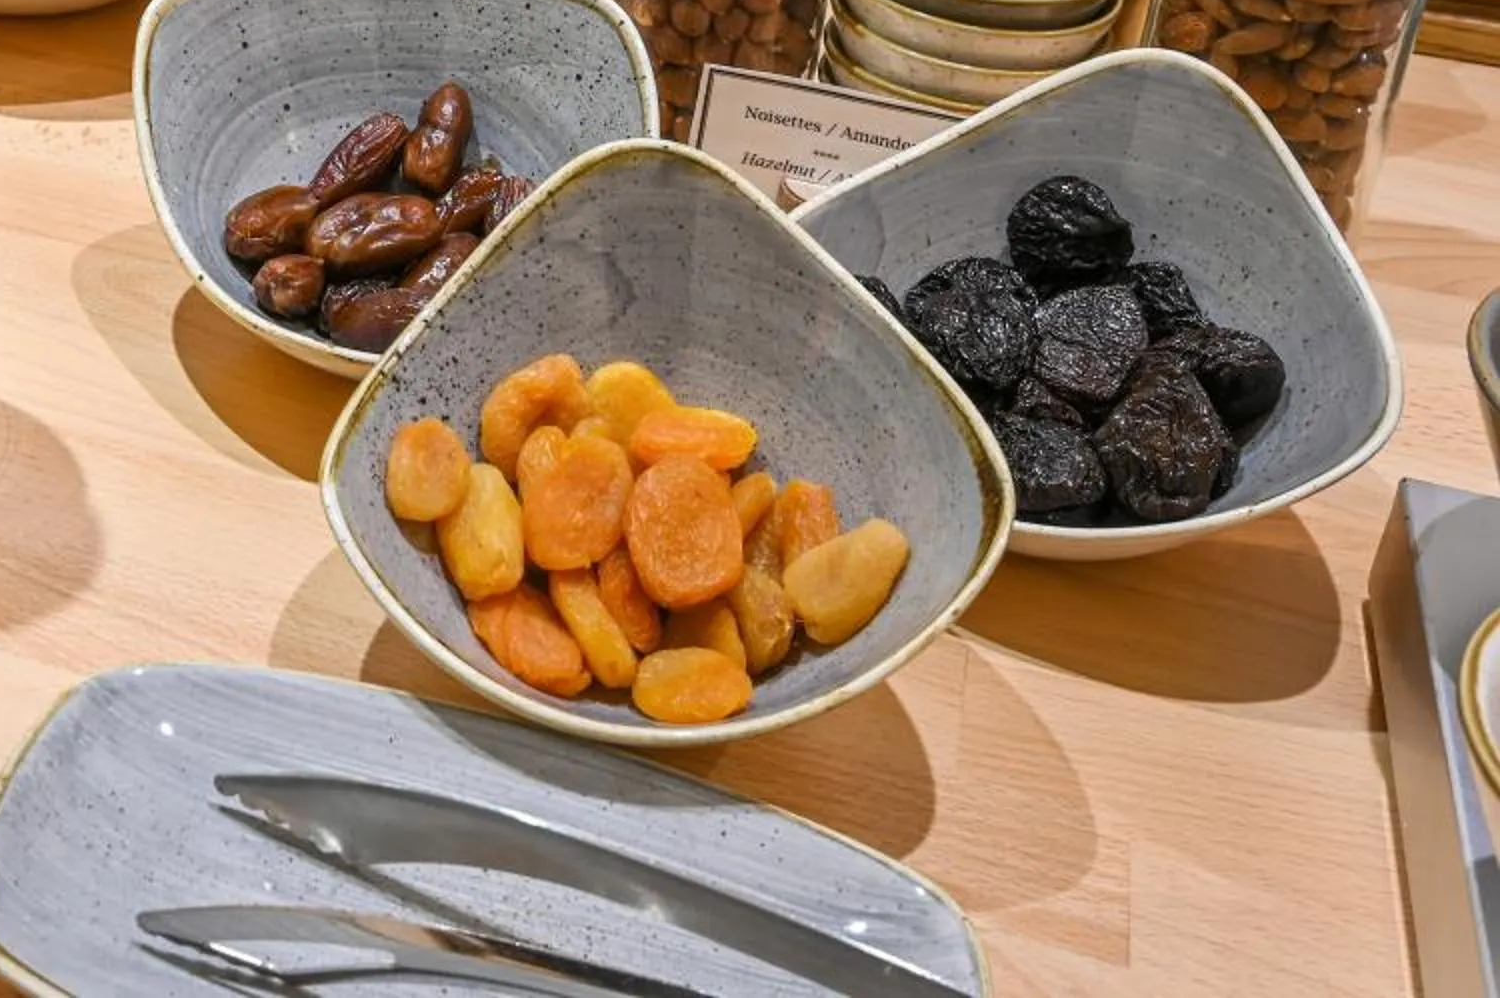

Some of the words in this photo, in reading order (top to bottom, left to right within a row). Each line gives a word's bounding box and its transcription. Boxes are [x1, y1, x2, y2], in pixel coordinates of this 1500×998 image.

[744, 105, 822, 133] Noisettes
[825, 123, 838, 137] /
[839, 126, 917, 150] Amande
[740, 151, 816, 179] Hazelnut
